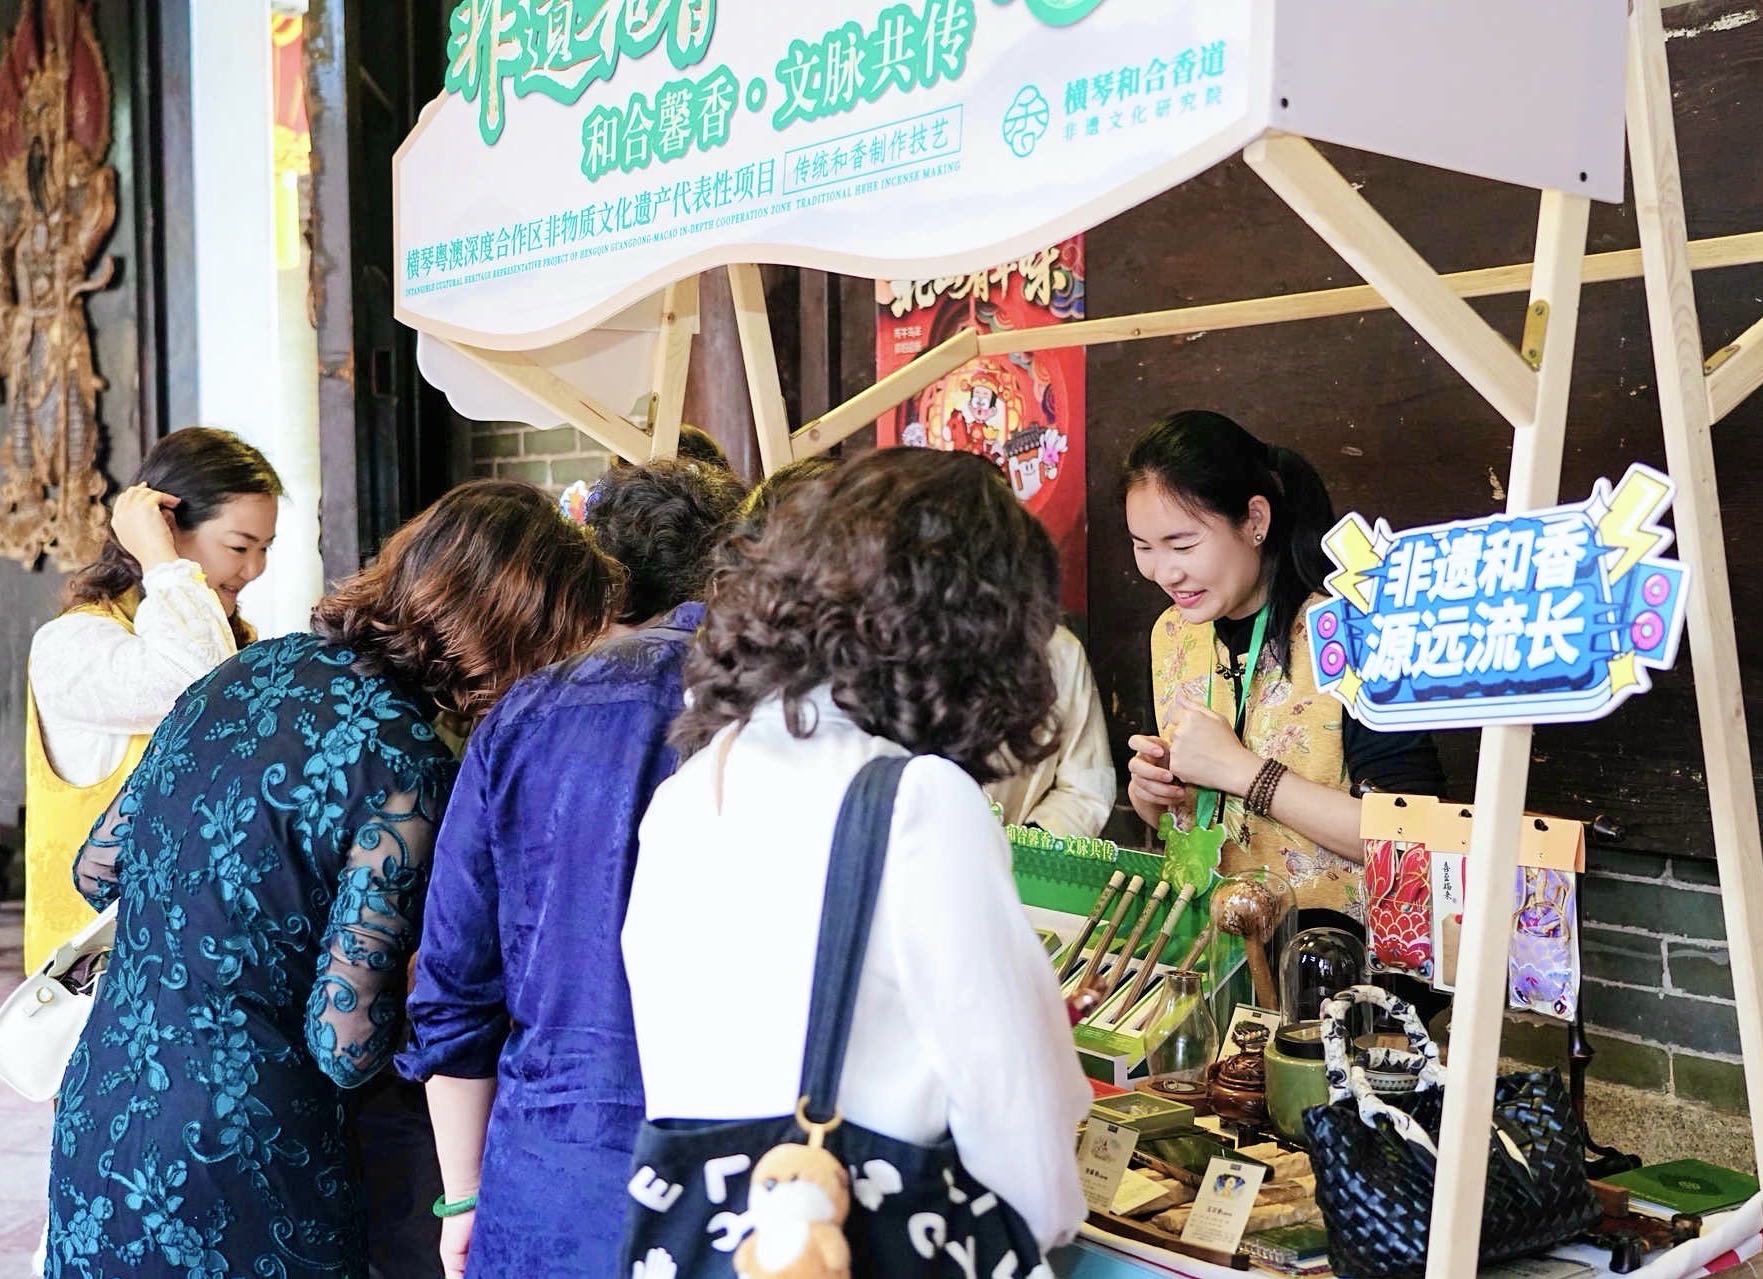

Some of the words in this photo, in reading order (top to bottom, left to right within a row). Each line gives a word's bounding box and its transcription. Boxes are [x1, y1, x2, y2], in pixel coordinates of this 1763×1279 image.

[794, 116, 949, 185] 传统和香制作技艺
[406, 158, 775, 280] 横琴粤澳深度合作区非物质文化遗产代表性项目
[543, 254, 569, 268] PROJECT
[569, 251, 579, 261] OF
[580, 245, 609, 260] HENGQIN
[715, 206, 769, 228] COOPERATION
[770, 201, 792, 216] ZONE
[797, 187, 851, 210] TRADITIONAL
[880, 171, 920, 191] INCENSE
[922, 160, 962, 179] MAKING
[1383, 522, 1590, 608] 非遗和香
[1359, 591, 1585, 683] 源远流长
